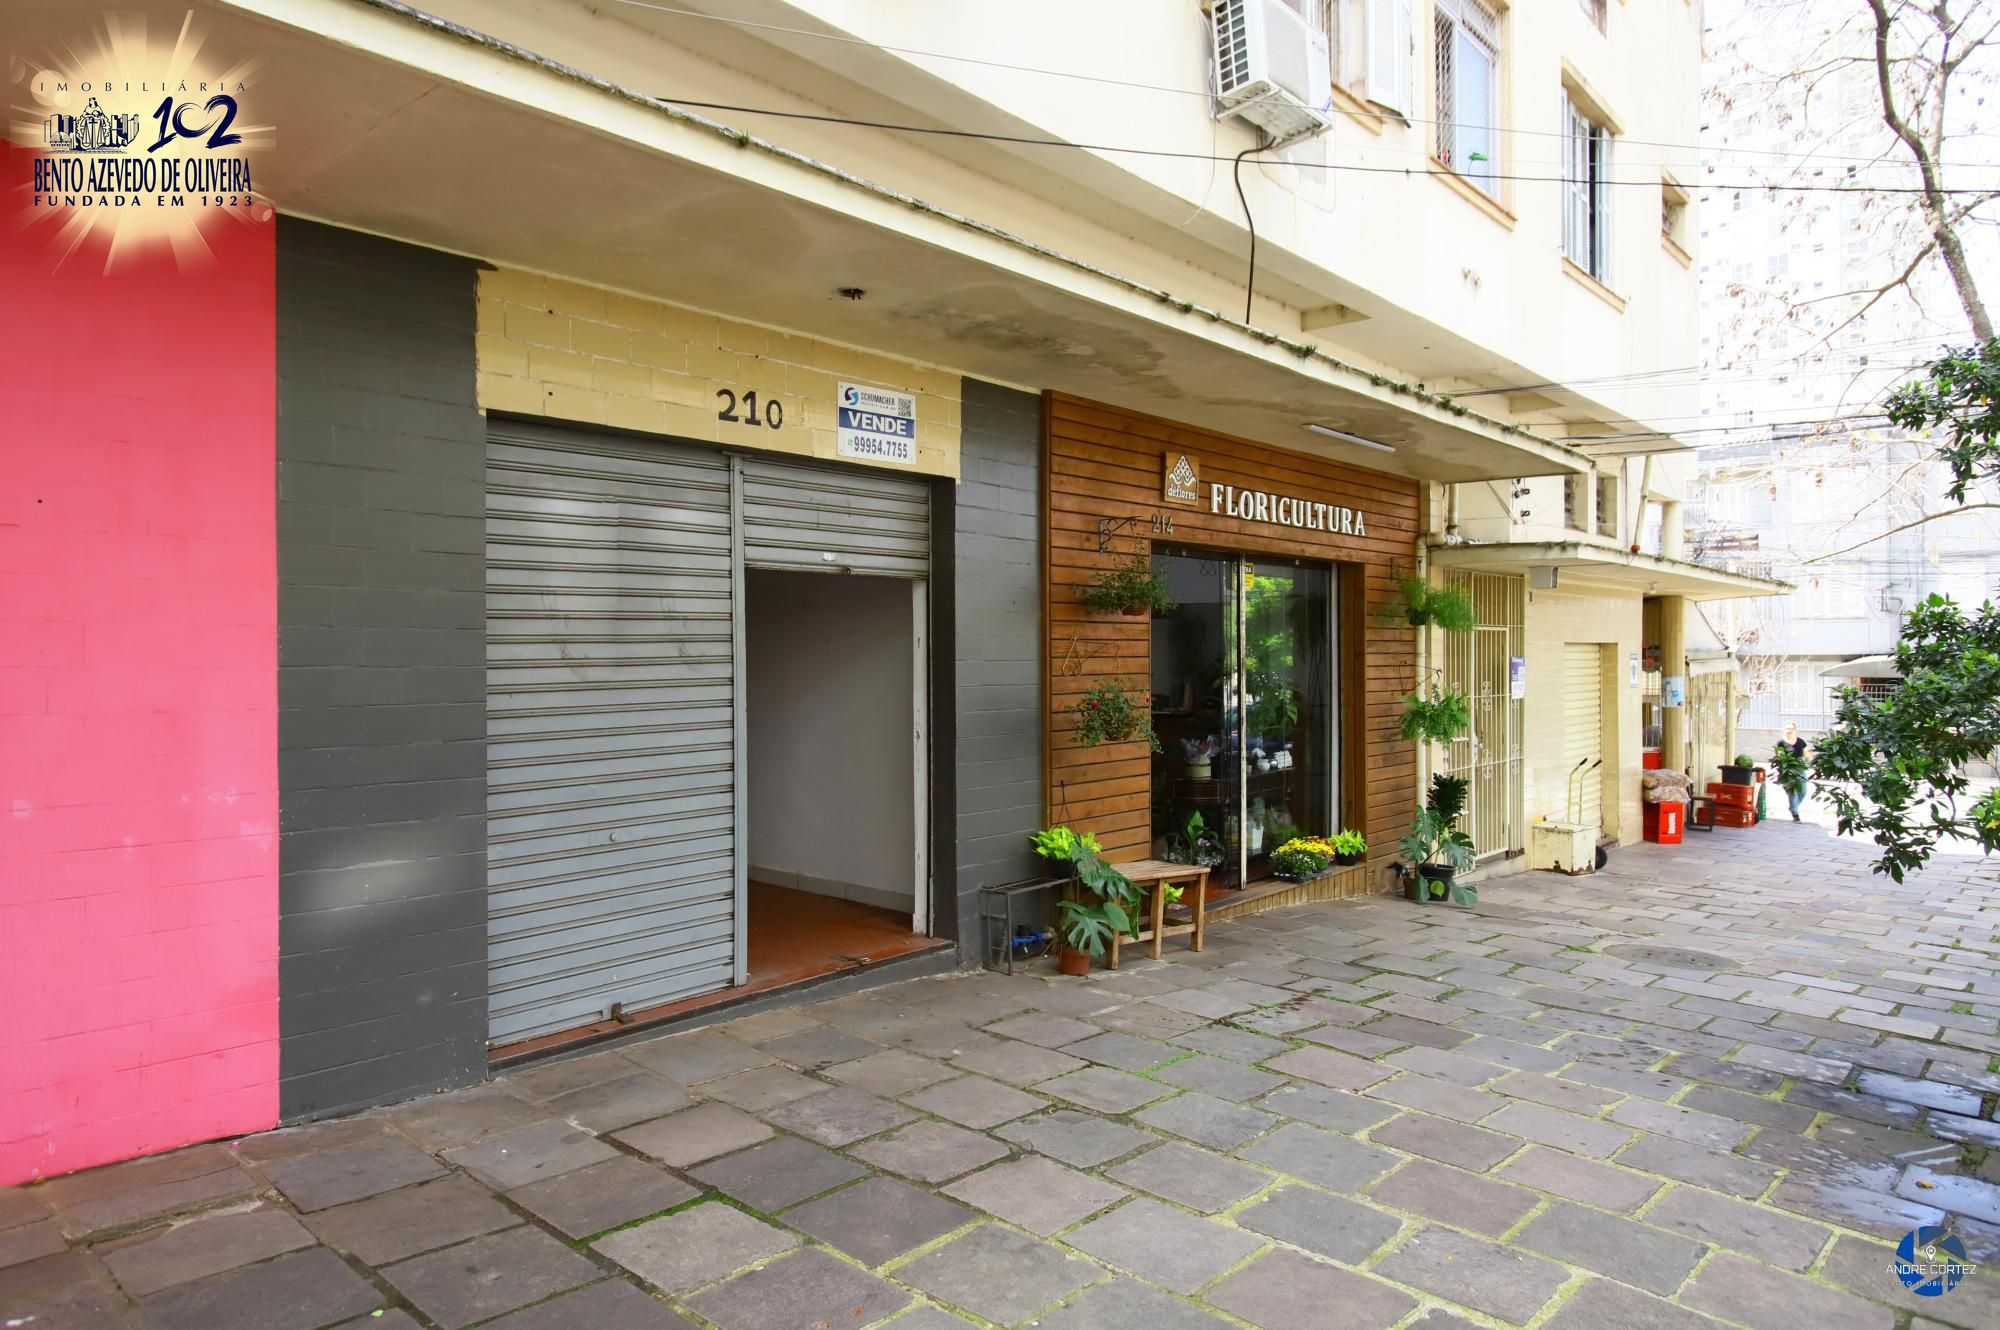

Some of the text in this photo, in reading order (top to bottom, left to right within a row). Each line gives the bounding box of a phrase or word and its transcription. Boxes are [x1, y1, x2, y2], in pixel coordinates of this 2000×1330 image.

[716, 388, 783, 430] 210
[847, 410, 907, 436] VENDE
[854, 435, 908, 459] 99954.7755
[1210, 483, 1367, 536] FLORICULTURA
